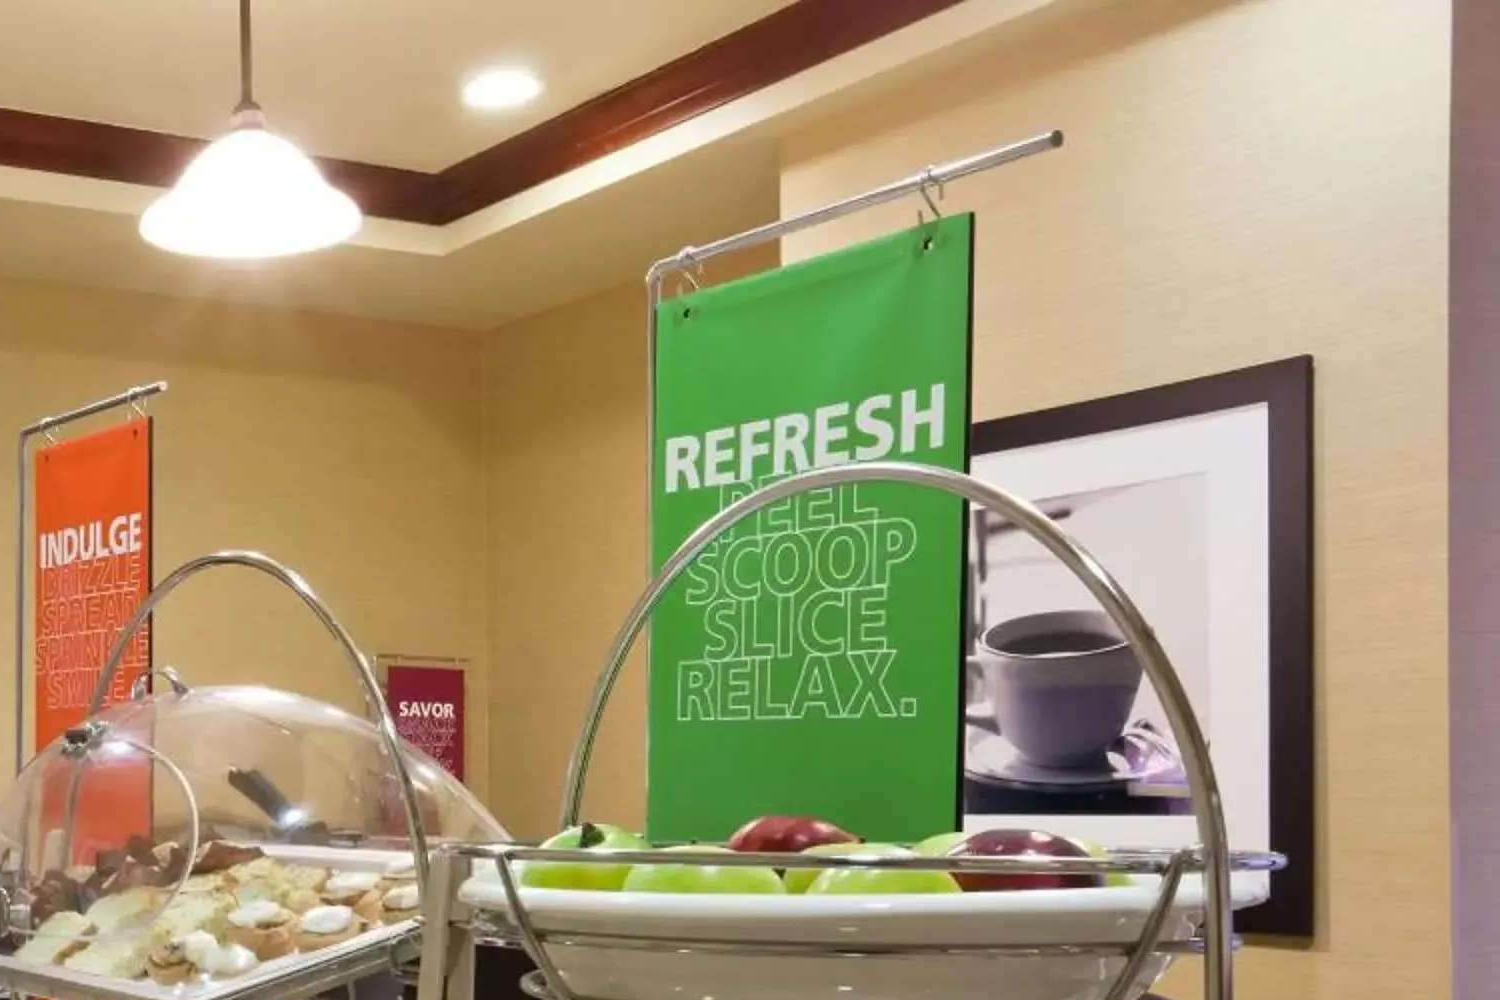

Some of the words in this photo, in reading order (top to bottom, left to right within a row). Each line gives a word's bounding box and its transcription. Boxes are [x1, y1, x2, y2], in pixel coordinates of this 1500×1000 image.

[664, 383, 946, 494] REFRESH
[39, 511, 143, 570] INDULGE
[685, 517, 918, 606] SCOOP
[41, 554, 142, 606] DRIZZLE
[703, 585, 889, 664] SLICE
[398, 701, 456, 719] SAVOR
[676, 649, 918, 722] RELAX.
